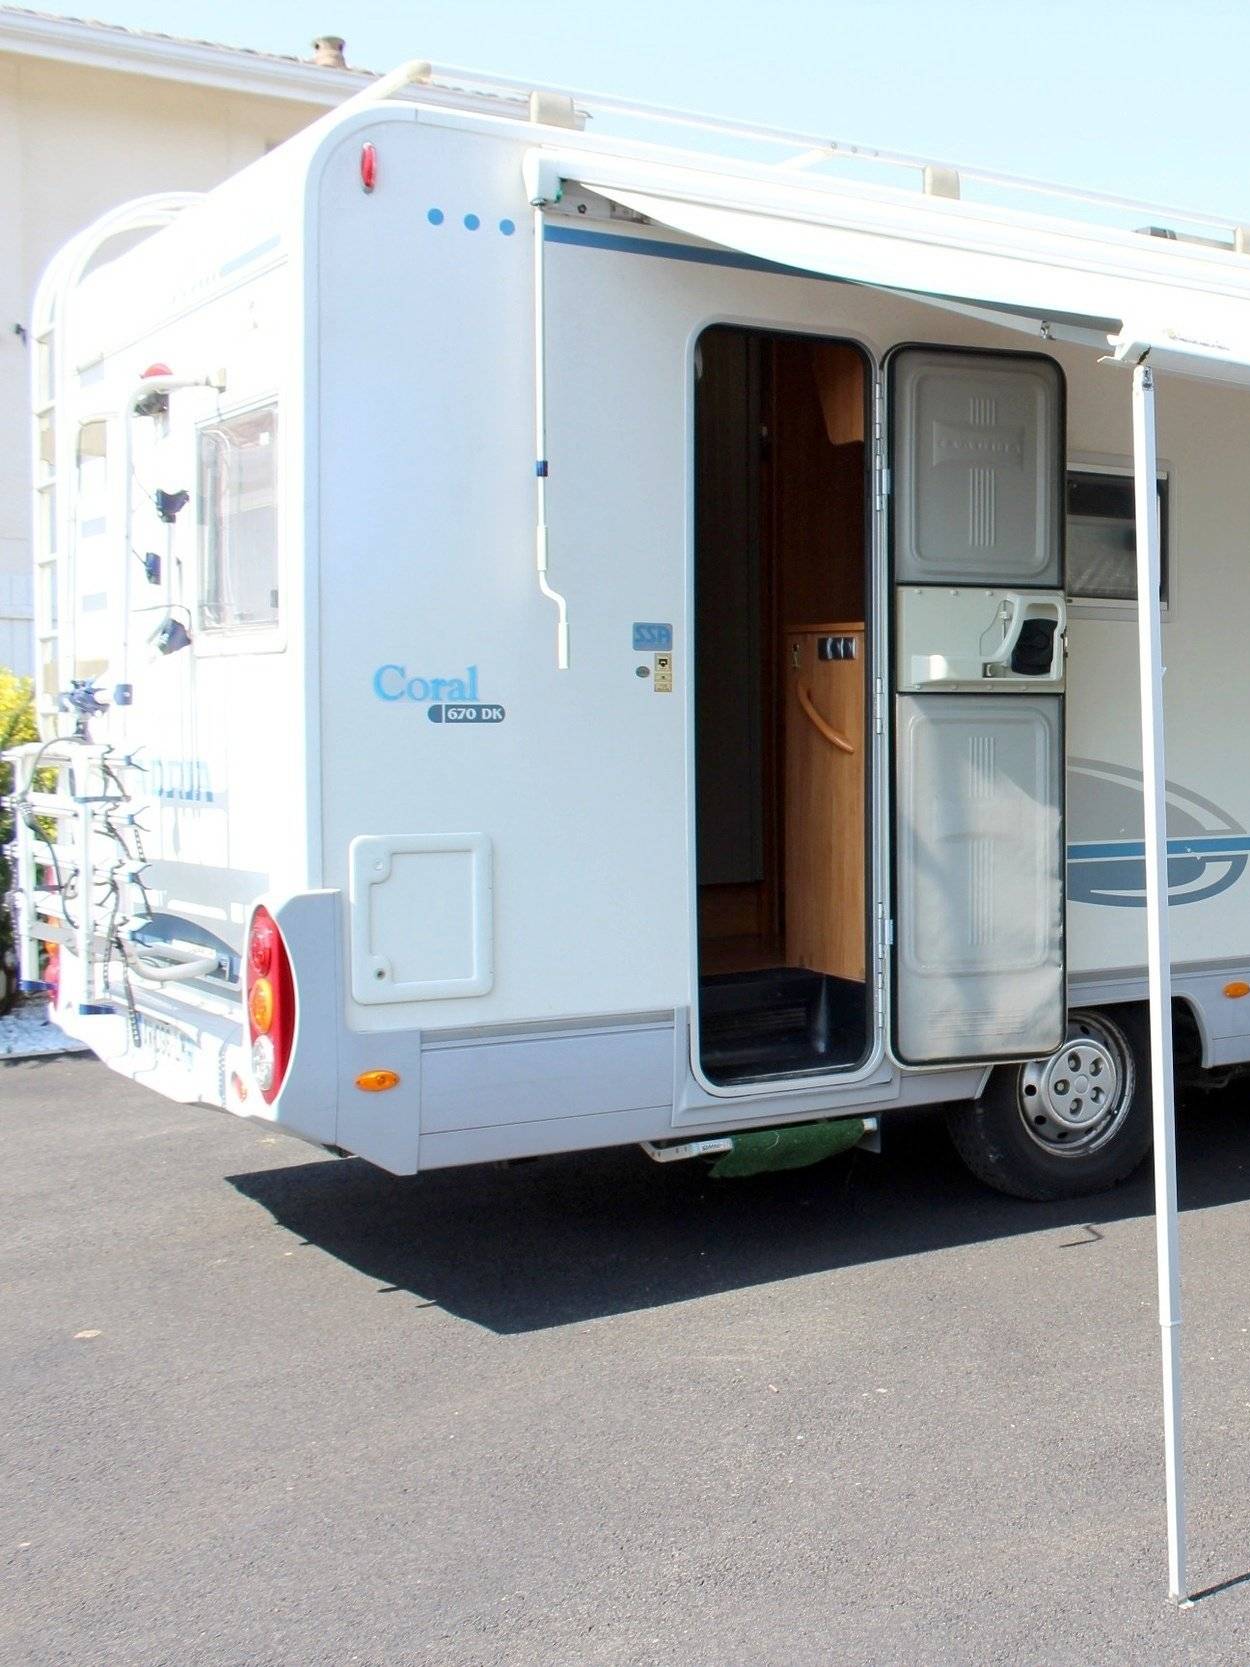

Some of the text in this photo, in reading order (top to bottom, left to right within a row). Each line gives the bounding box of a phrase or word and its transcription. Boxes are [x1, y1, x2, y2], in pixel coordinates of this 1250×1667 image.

[374, 664, 480, 701] Coral
[447, 708, 503, 720] 670 DK
